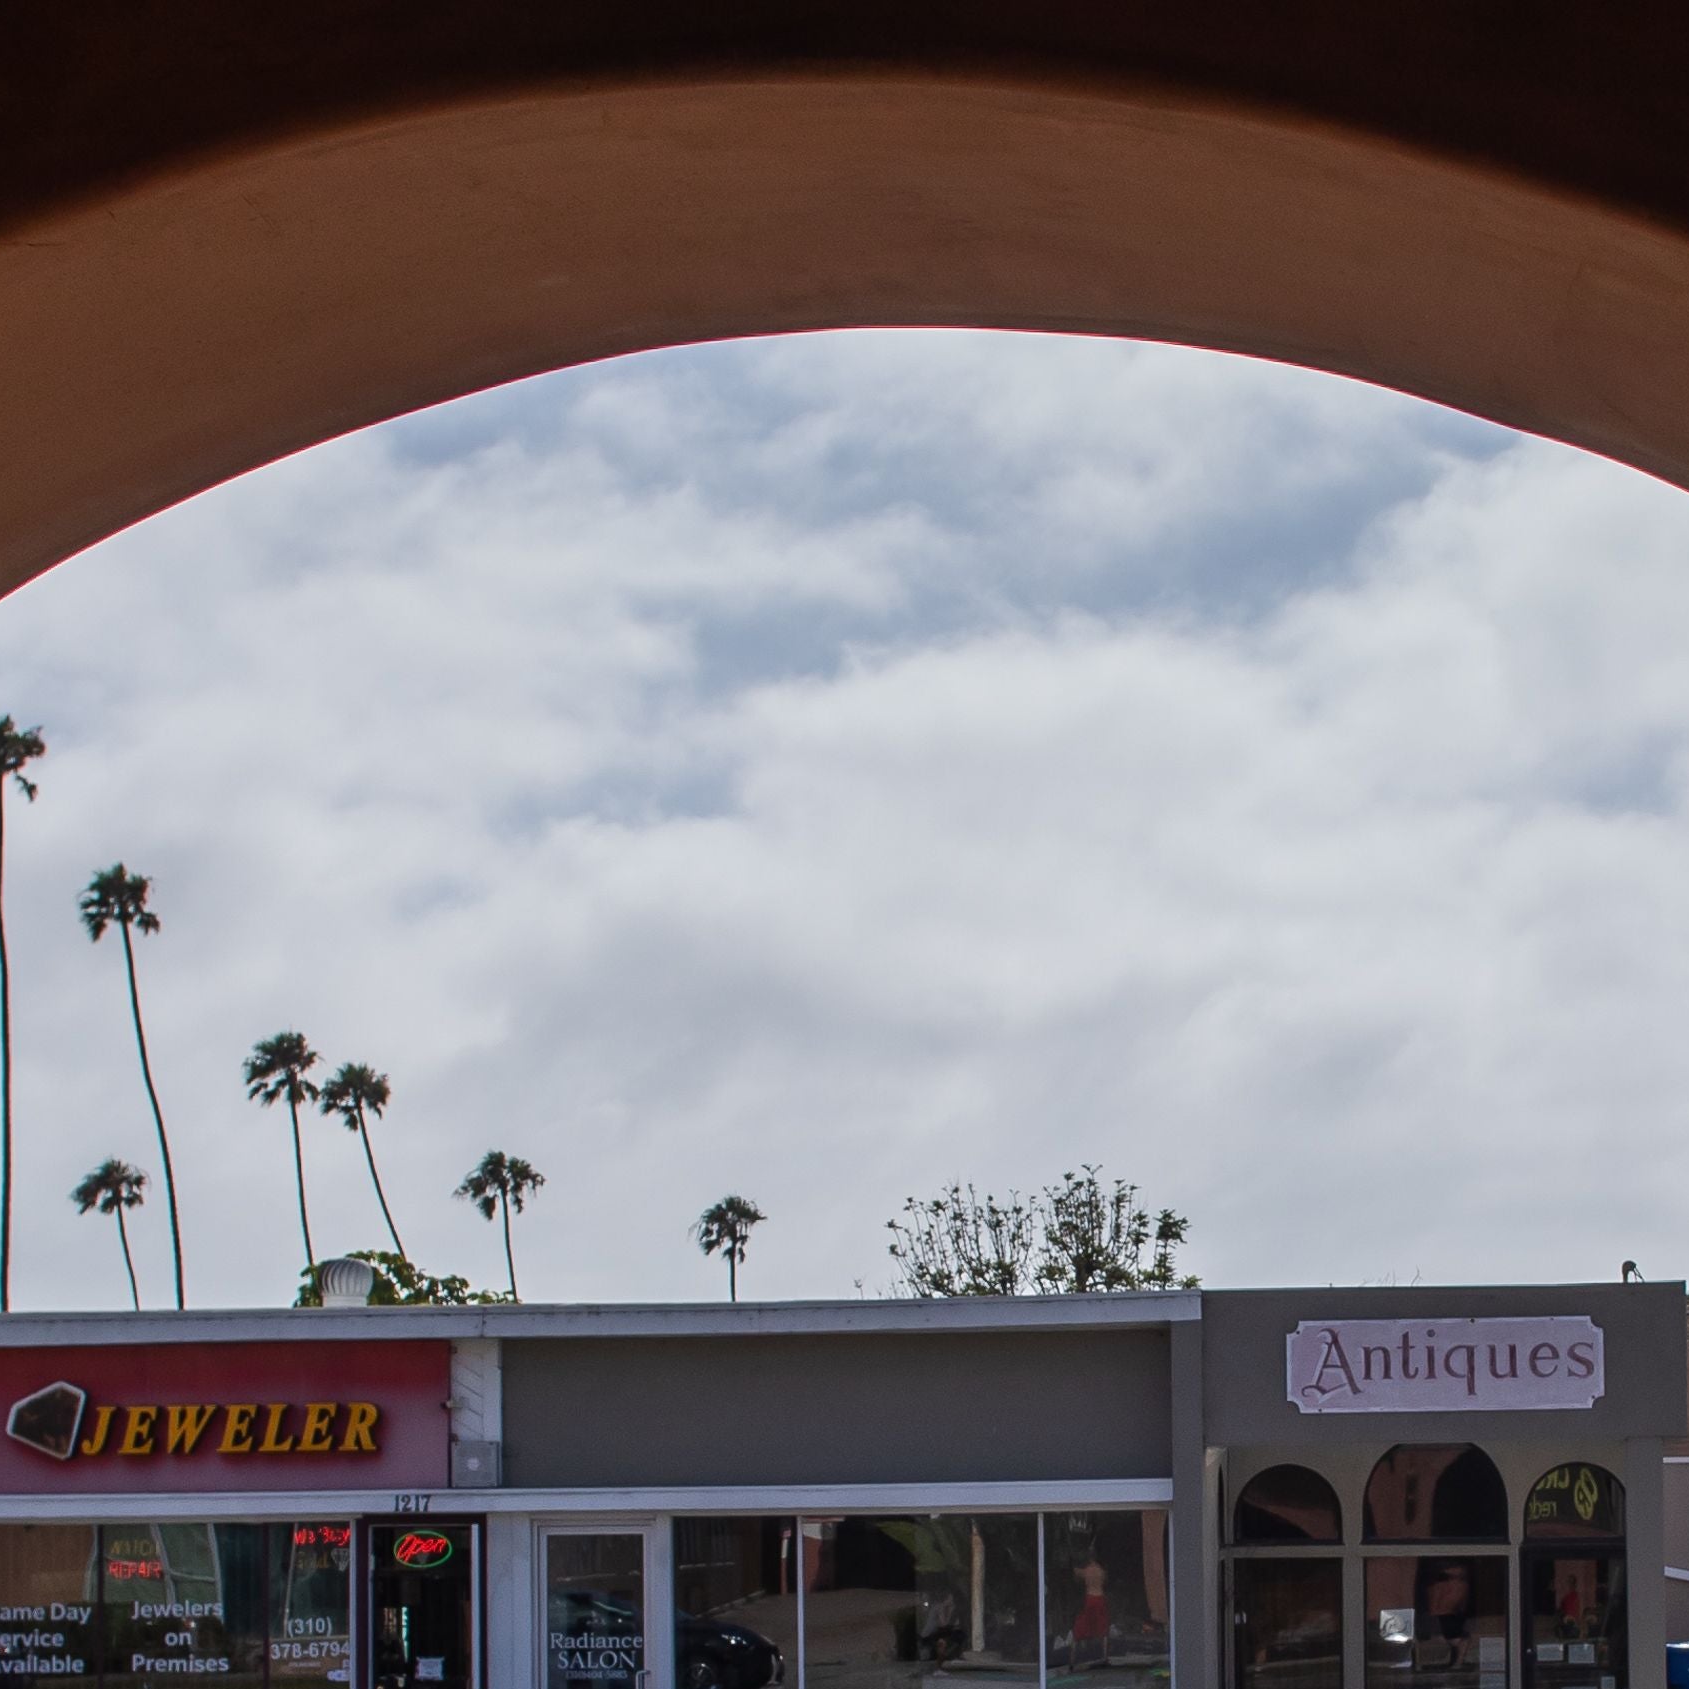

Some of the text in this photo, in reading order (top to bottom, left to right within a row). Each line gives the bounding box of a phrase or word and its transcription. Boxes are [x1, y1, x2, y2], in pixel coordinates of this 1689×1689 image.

[1302, 1327, 1596, 1398] Antiques
[80, 1401, 381, 1456] JEWELER
[394, 1494, 433, 1513] 1217
[396, 1533, 448, 1563] Open
[50, 1603, 92, 1625] Day
[131, 1600, 224, 1620] Jewelers
[287, 1615, 333, 1637] (310)
[164, 1631, 193, 1645] on
[550, 1631, 644, 1649] Radiance
[131, 1653, 230, 1672] Premises
[557, 1650, 637, 1669] SALON
